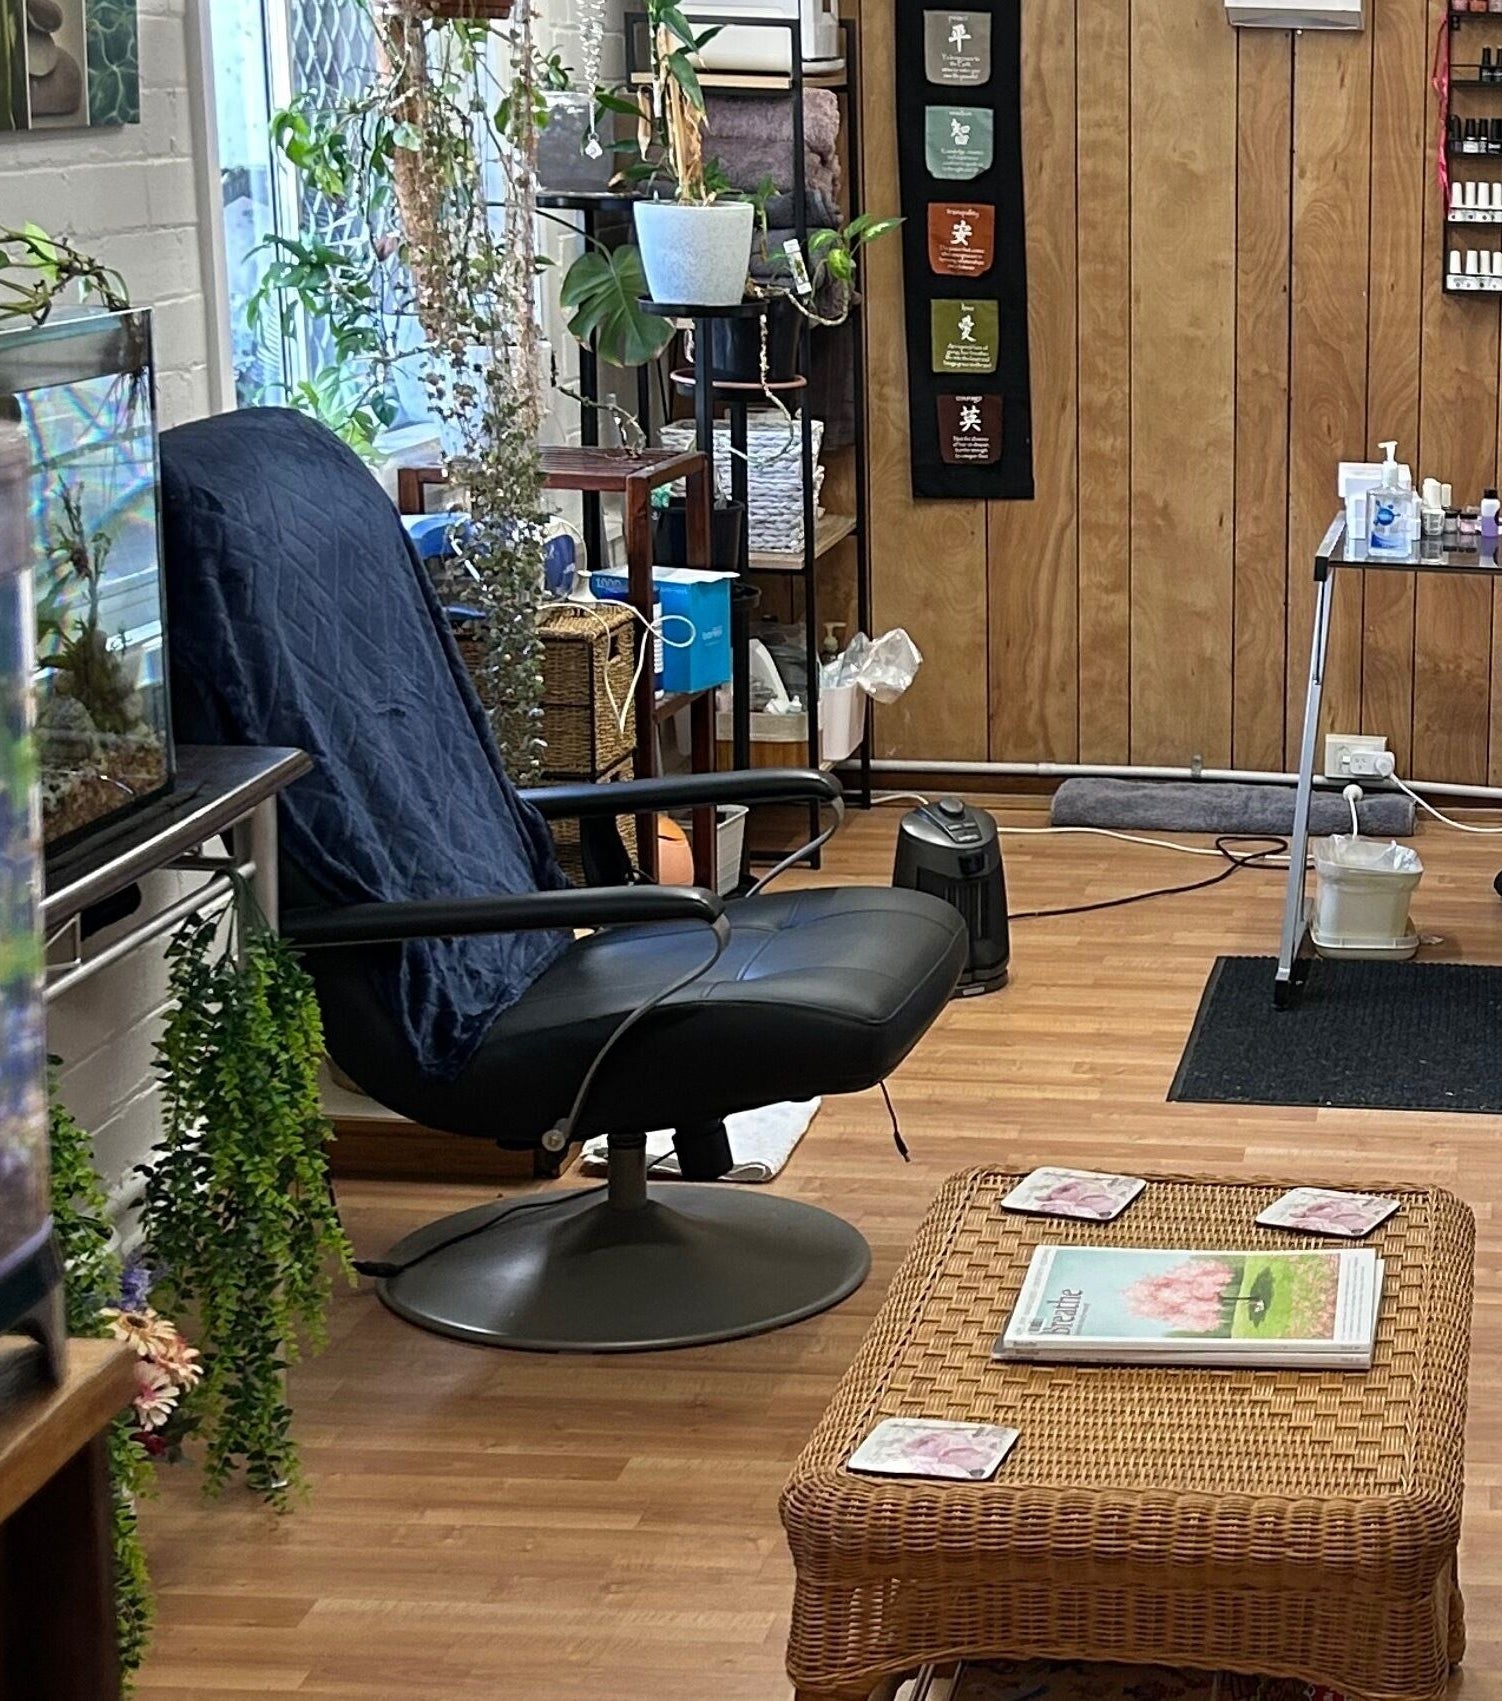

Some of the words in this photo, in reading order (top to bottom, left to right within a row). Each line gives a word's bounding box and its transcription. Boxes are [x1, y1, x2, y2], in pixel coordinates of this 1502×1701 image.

[948, 23, 972, 53] 平
[950, 117, 971, 146] 智
[950, 219, 973, 246] 安
[959, 405, 982, 432] 英
